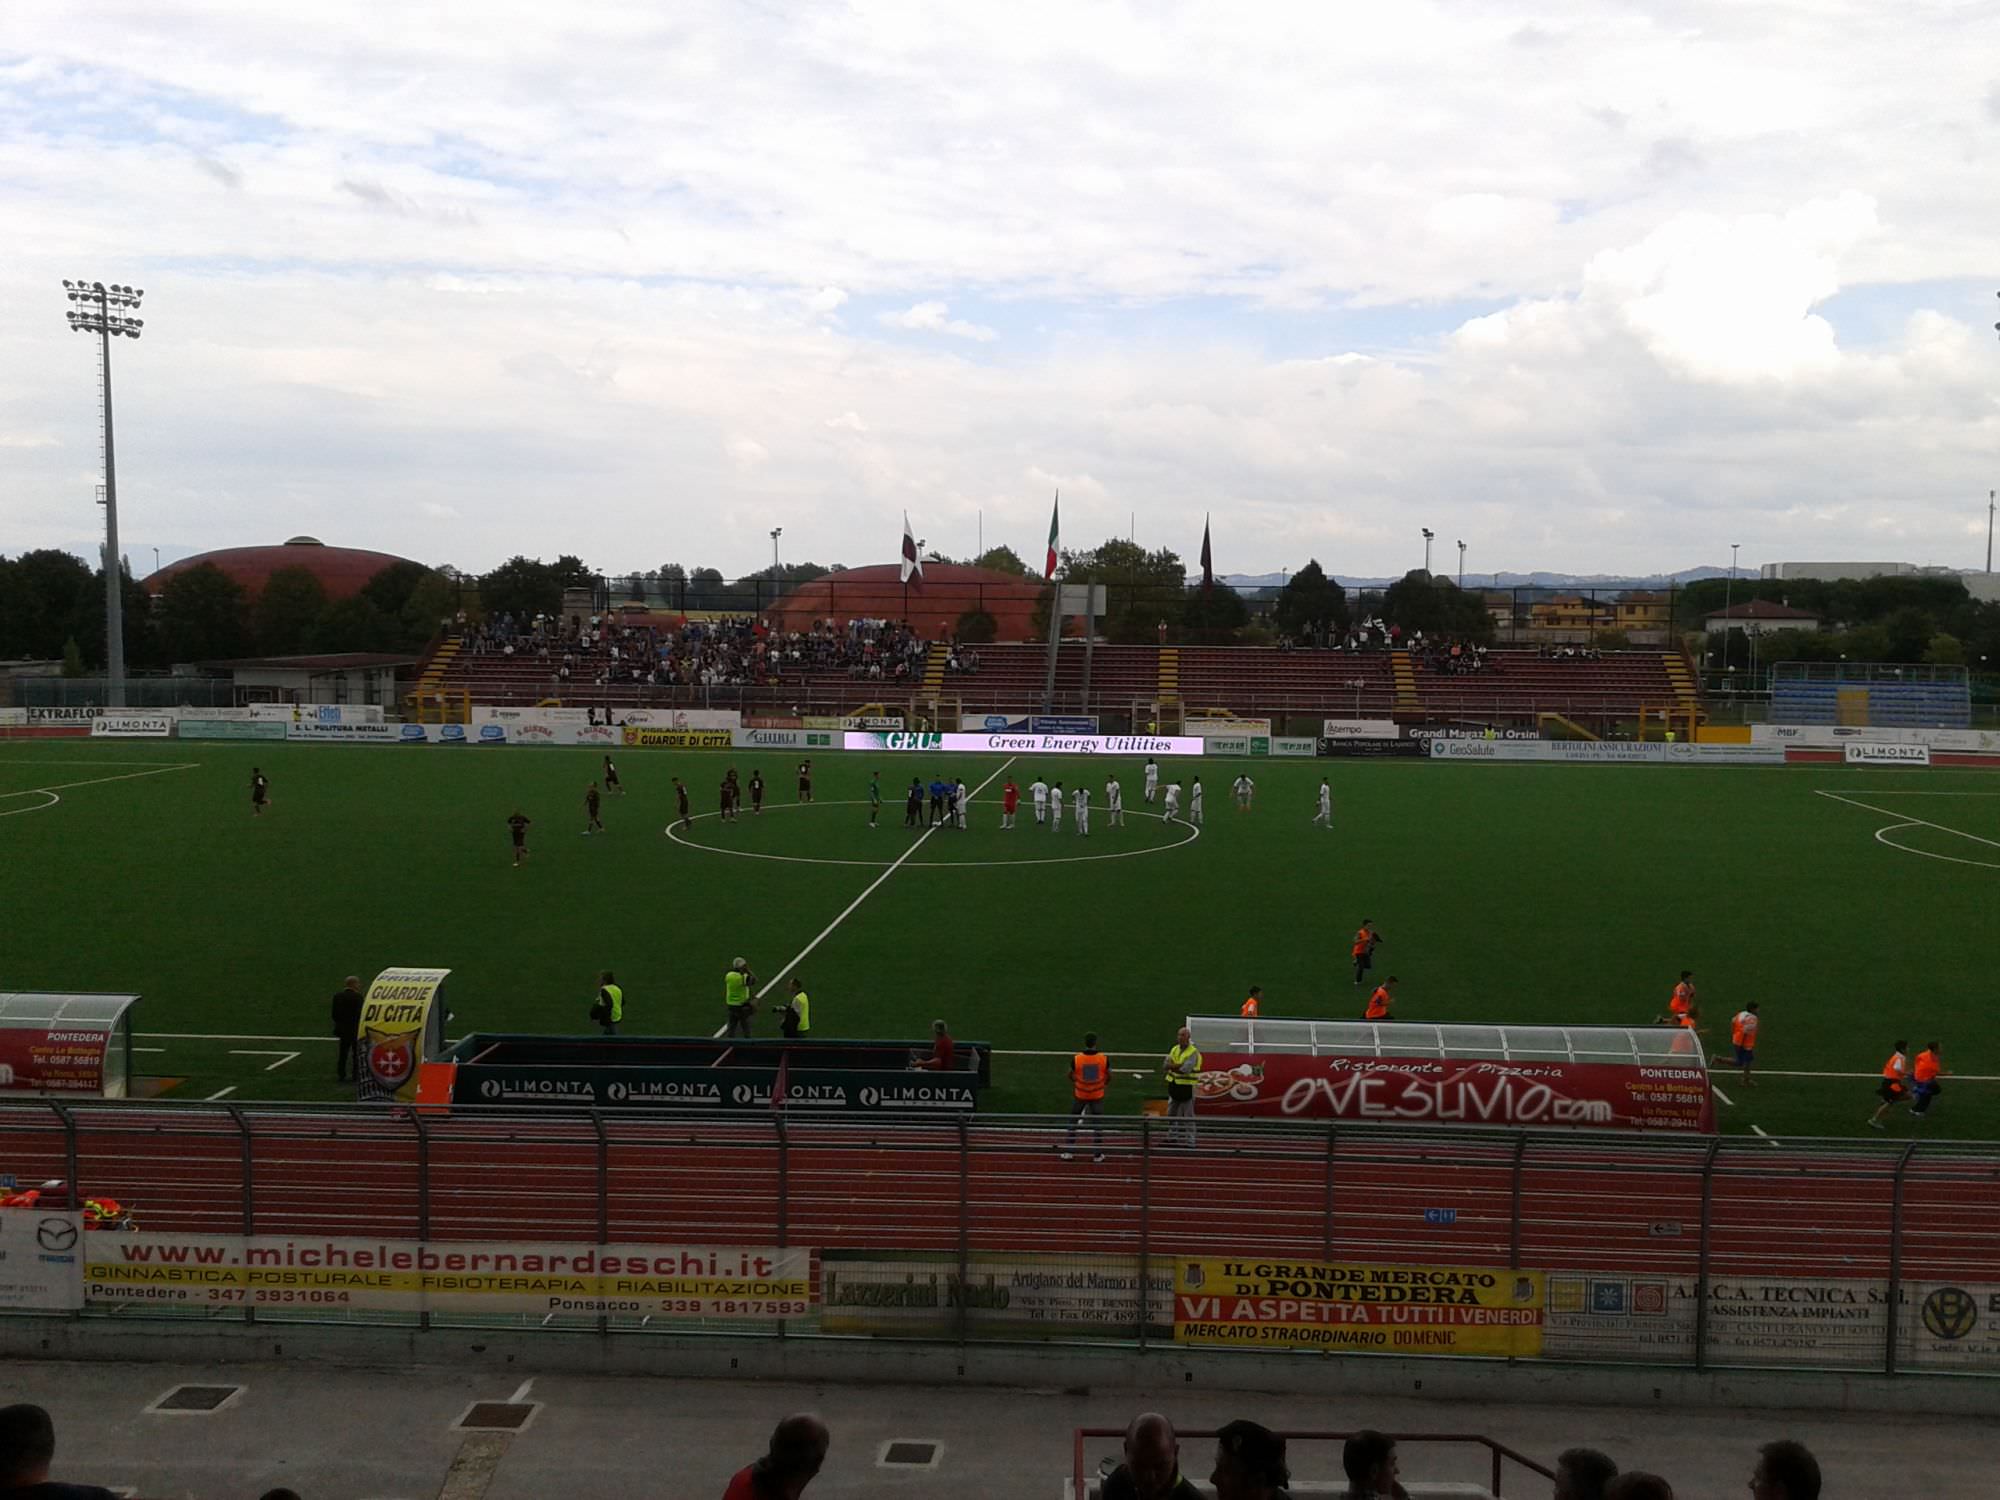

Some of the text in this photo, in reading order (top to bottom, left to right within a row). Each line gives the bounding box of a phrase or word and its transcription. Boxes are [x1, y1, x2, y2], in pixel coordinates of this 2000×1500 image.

[30, 707, 104, 719] EXTRAFLOR
[108, 720, 167, 729] LIMONTA
[641, 735, 686, 745] GUARDIE
[690, 736, 701, 745] DI
[1408, 728, 1540, 739] Grandi Magazni Orsini
[988, 735, 1036, 749] Green
[1042, 736, 1100, 753] Energy
[1104, 736, 1172, 751] Utilities
[1863, 747, 1925, 756] LIMONTA
[371, 986, 432, 1001] GUARDIE
[364, 1004, 381, 1022] DI
[47, 1032, 104, 1042] PONTEDERA
[1328, 1057, 1444, 1074] Ristorante
[1478, 1063, 1564, 1079] Pizzeria
[1639, 1067, 1703, 1080] PONTEDERA
[502, 1080, 595, 1093] LIMONTA
[628, 1082, 721, 1096] LIMONTA
[753, 1085, 847, 1098] LIONTA
[880, 1087, 974, 1101] LIMONTA
[1631, 1091, 1649, 1101] Tel.
[120, 1243, 773, 1277] www.michelebernardeschi.it
[91, 1266, 238, 1283] GINNASTICA
[247, 1271, 393, 1286] POSTURALE
[422, 1276, 586, 1291] FISIOTERAPIA
[616, 1280, 804, 1295] RIABILITAZIONE
[1011, 1270, 1064, 1290] Artigiano
[1066, 1272, 1084, 1288] del
[1087, 1273, 1127, 1289] Marmo
[1223, 1263, 1496, 1288] IL GRANDE MERCATO
[91, 1284, 188, 1299] Pontedera
[208, 1288, 245, 1301] 347
[255, 1289, 350, 1302] 3931064
[1235, 1279, 1481, 1305] DI PONTEDERA
[1760, 1286, 1856, 1304] TECNICA
[549, 1296, 640, 1312] Ponsacco
[661, 1300, 702, 1312] 339
[711, 1301, 805, 1314] 1817593
[1181, 1296, 1221, 1320] VI
[1231, 1299, 1370, 1323] ASPETTA
[1376, 1305, 1444, 1324] TUTTI
[1448, 1307, 1455, 1324] I
[1710, 1304, 1797, 1318] ASSISTENZA
[1183, 1323, 1258, 1338] MERCATO
[1260, 1326, 1387, 1345] STRAORDINARIO
